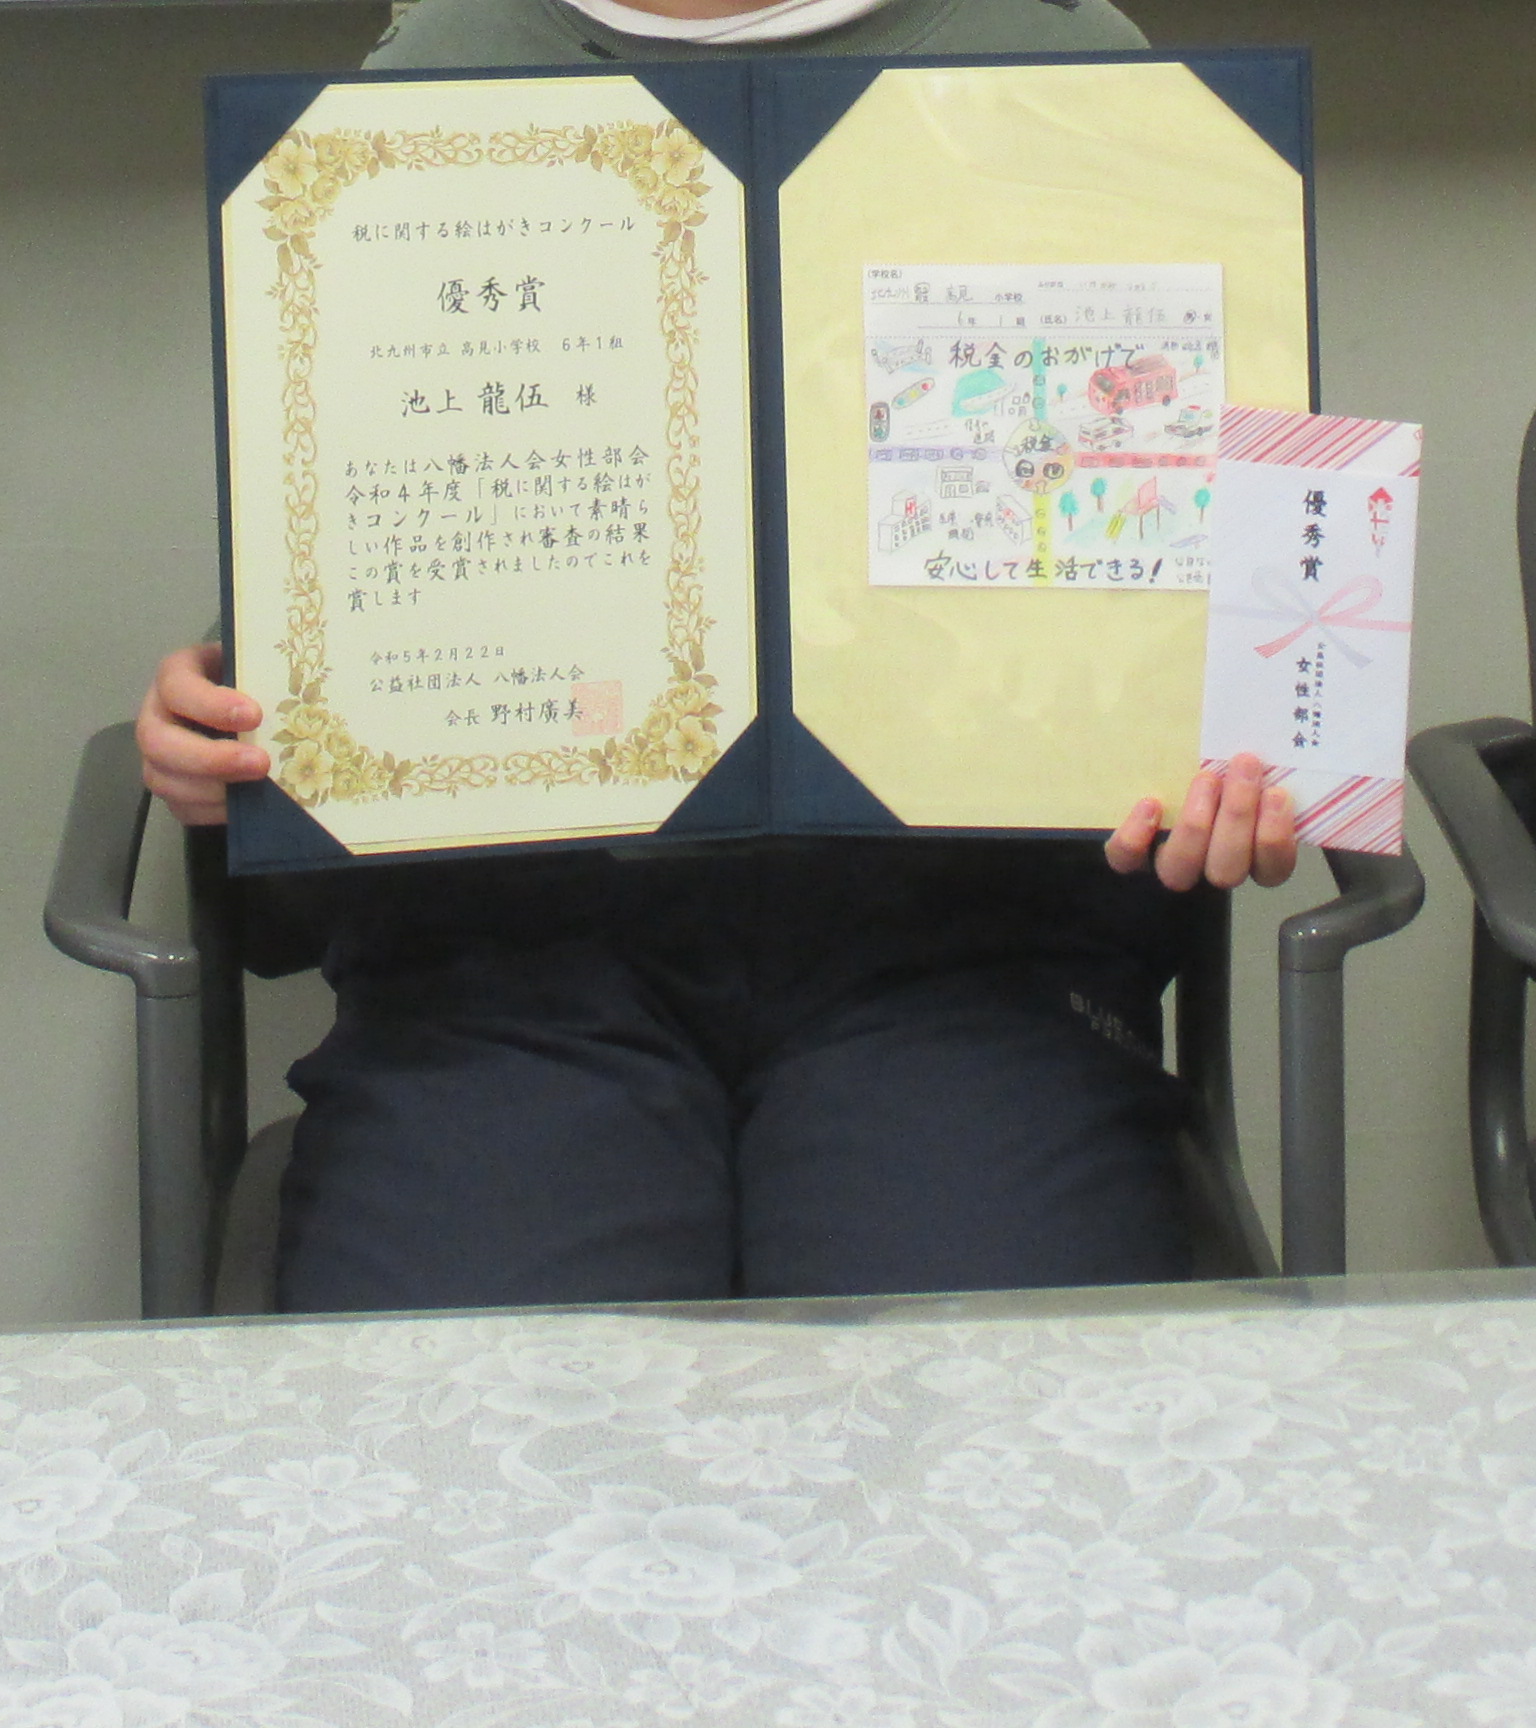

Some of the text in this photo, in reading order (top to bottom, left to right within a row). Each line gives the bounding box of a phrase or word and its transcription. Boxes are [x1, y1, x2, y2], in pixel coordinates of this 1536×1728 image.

[352, 216, 635, 242] 税に関する絵はがきコンクール
[436, 274, 546, 314] 優秀賞
[370, 342, 450, 359] 北九州市立
[461, 338, 540, 357] 高見小学校
[401, 381, 596, 418] 池上 龍伍 様
[345, 444, 651, 478] あなたは八幡法人会女性部会
[348, 522, 651, 556] しい作品を創作され審査の結果
[1299, 489, 1328, 583] 優秀賞
[347, 588, 422, 613] 賞します
[370, 645, 507, 666] 令和5年2月22日
[370, 663, 585, 694] 公益社団法人 八幡法人会
[446, 708, 480, 727] 会長
[1292, 656, 1312, 748] 女性部会
